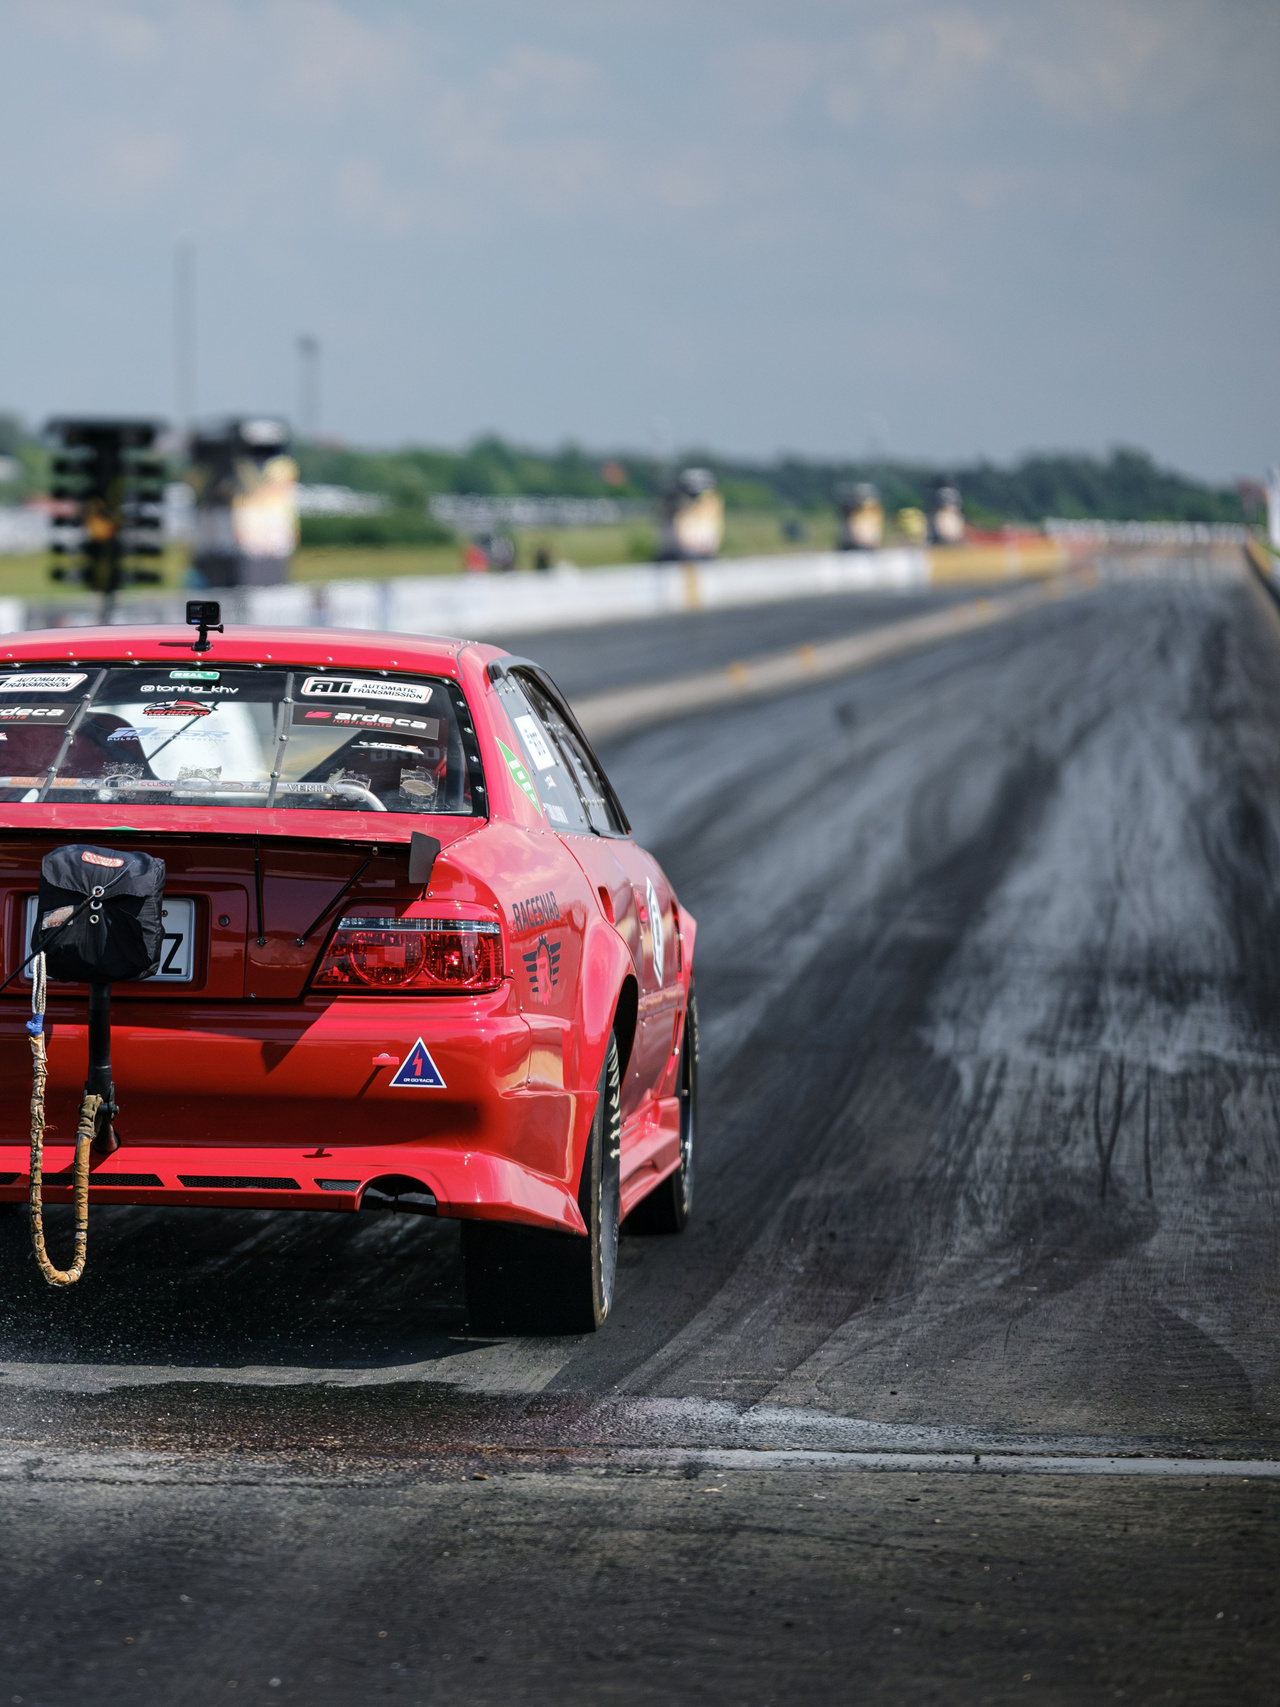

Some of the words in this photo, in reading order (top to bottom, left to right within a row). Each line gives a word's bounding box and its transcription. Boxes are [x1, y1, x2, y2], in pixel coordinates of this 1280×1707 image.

[140, 684, 239, 694] @toning_khv
[361, 683, 417, 693] AUTOMATIC
[352, 688, 423, 700] TRANSMISSION
[332, 719, 393, 729] lubricants
[334, 712, 428, 730] ardeca
[287, 783, 338, 793] VERTEX
[512, 891, 560, 933] RACESNAB
